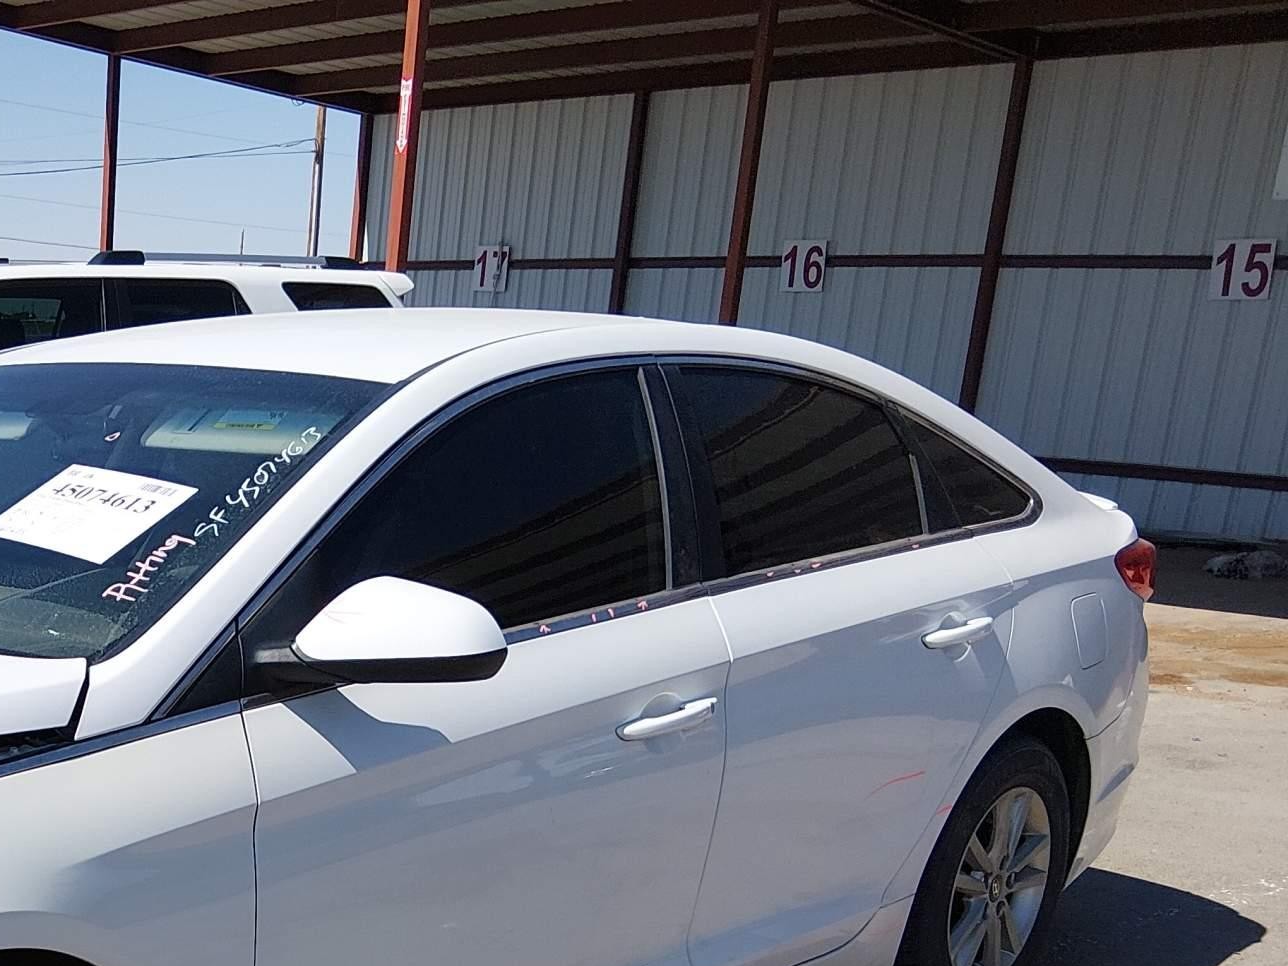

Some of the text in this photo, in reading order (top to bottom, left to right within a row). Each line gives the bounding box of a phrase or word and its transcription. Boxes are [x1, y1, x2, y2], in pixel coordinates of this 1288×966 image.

[476, 249, 508, 288] 17
[783, 245, 824, 289] 16
[1215, 243, 1272, 298] 15
[51, 482, 157, 514] 45074613
[193, 425, 323, 538] SF 45074613
